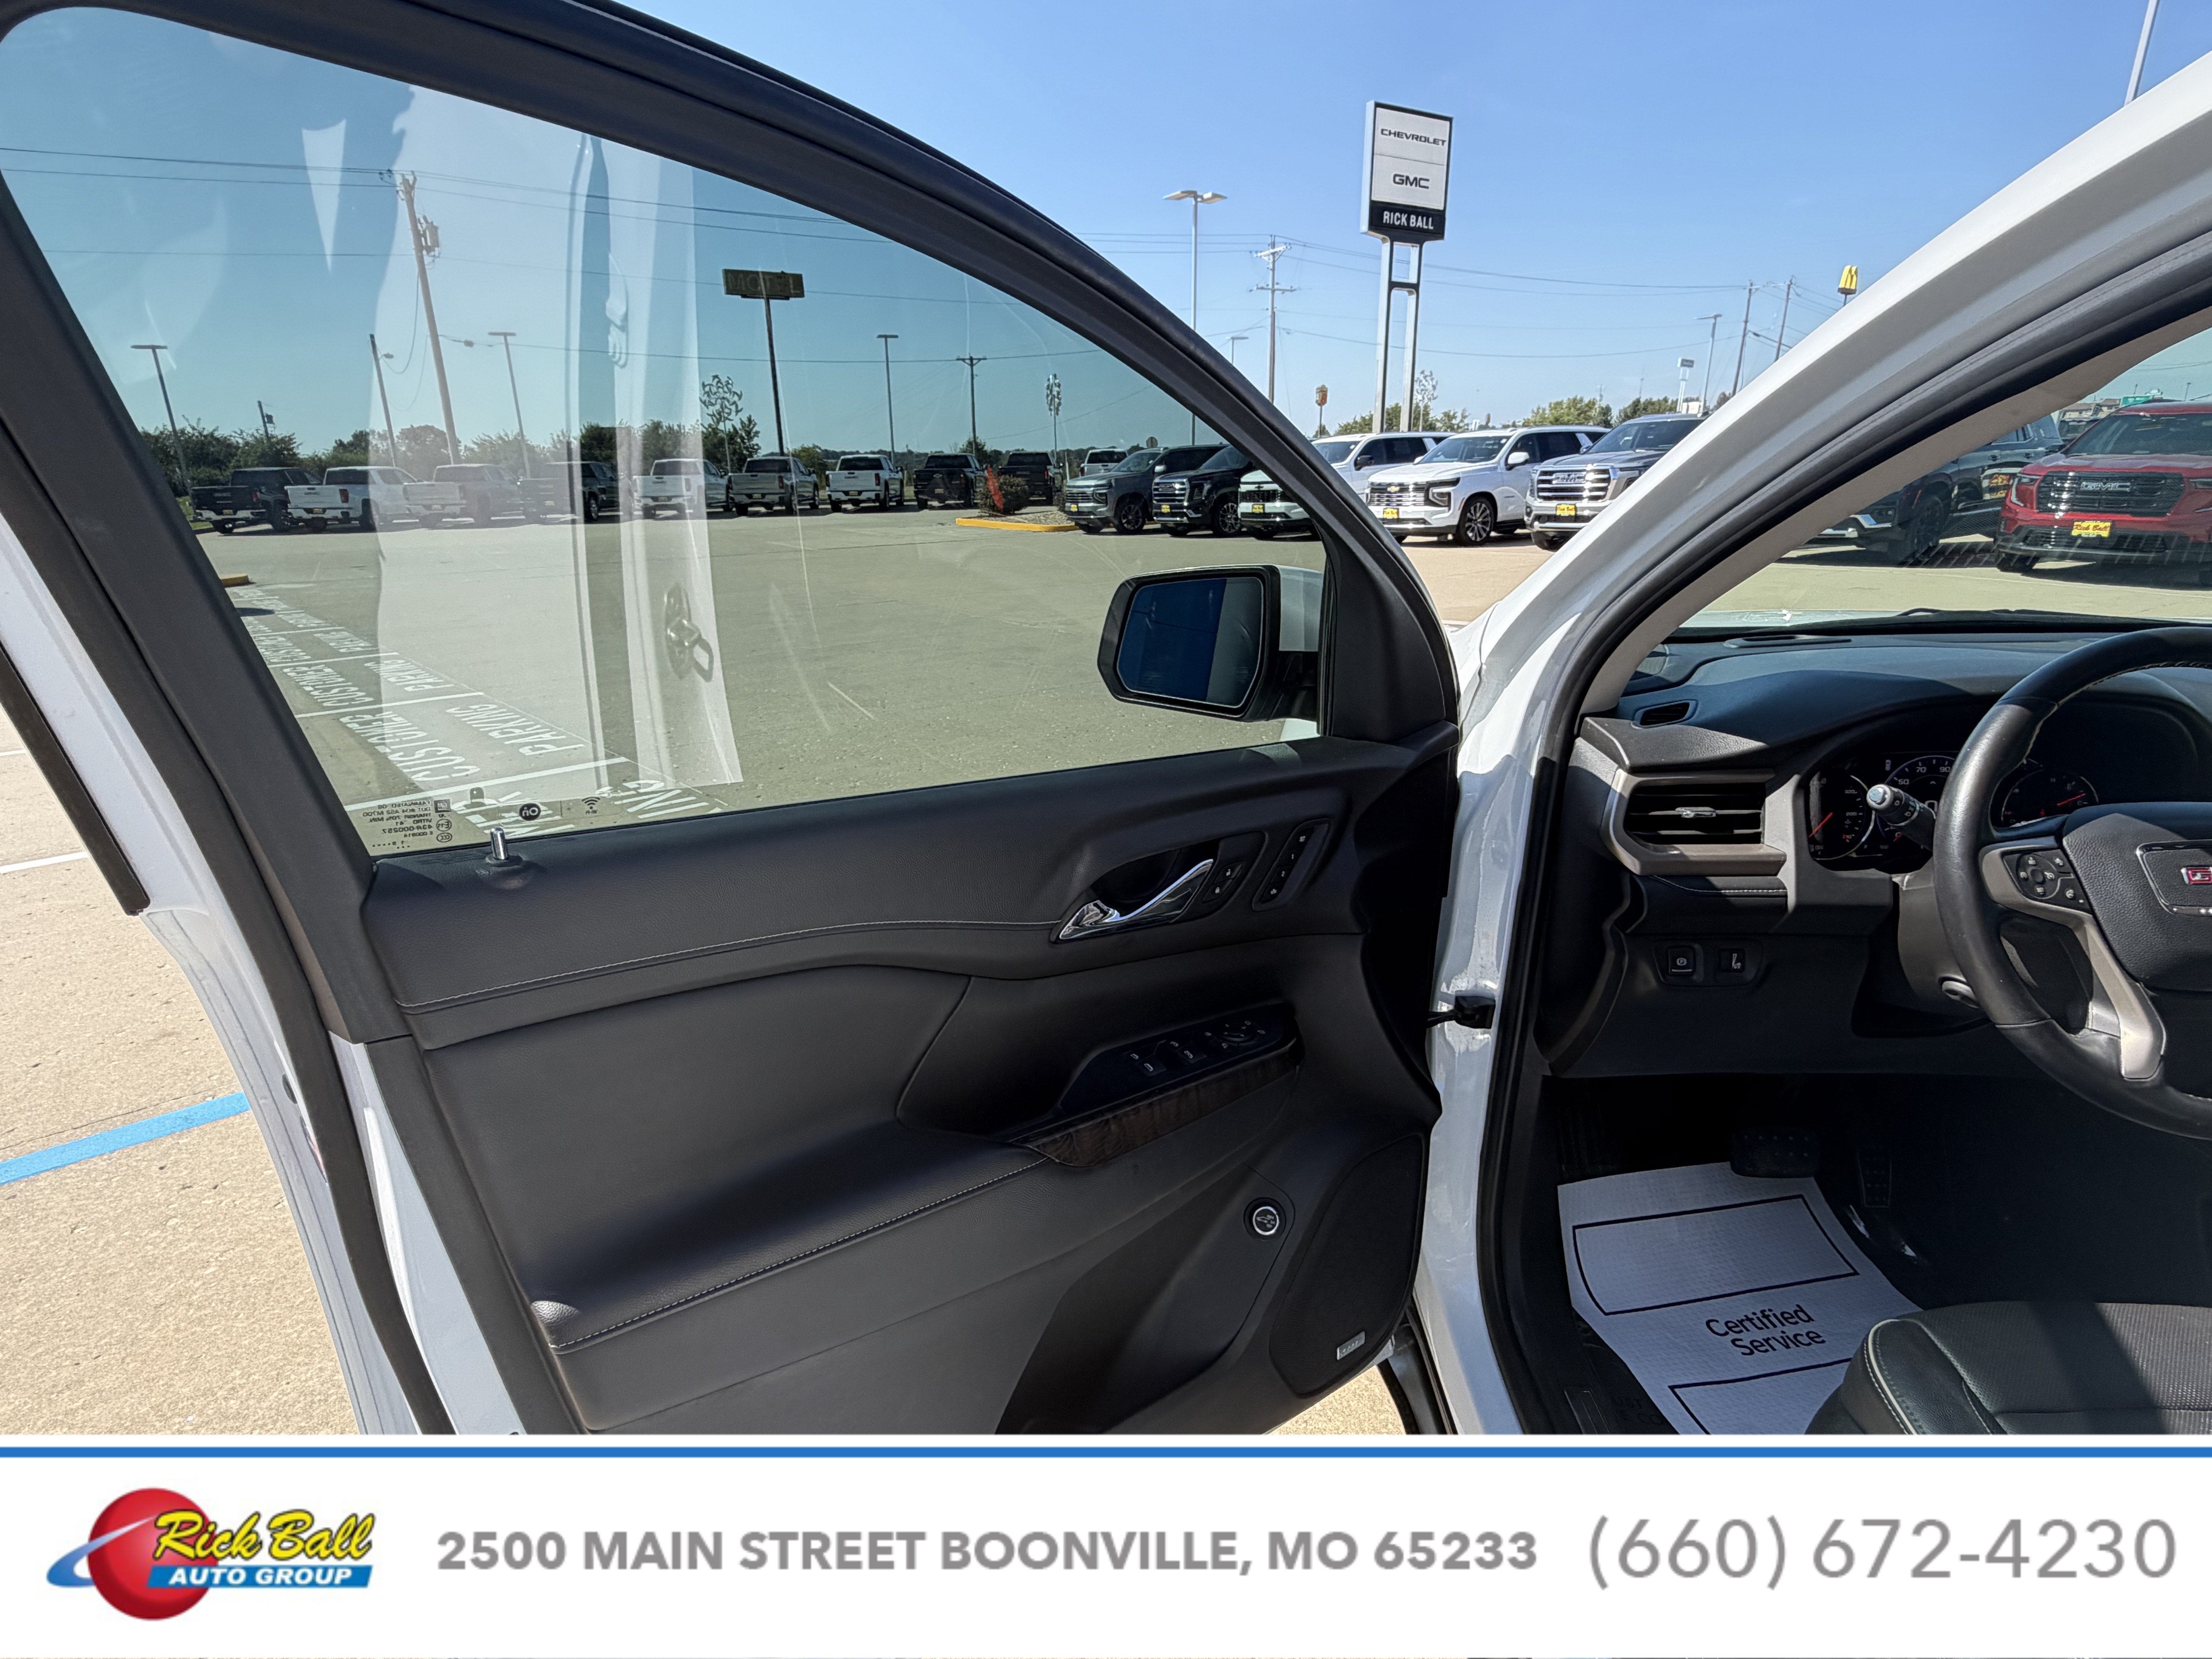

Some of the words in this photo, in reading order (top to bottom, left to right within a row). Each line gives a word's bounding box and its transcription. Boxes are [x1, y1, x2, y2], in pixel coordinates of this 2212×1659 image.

[1381, 129, 1446, 146] CHEVROLET
[1393, 173, 1430, 189] GMC
[1383, 211, 1407, 226] RICK
[1410, 215, 1434, 230] BALL
[728, 272, 801, 294] MOTL
[2080, 482, 2131, 492] GMC
[446, 704, 585, 756] PARKING
[339, 711, 480, 781] CUSTOMER
[1705, 1304, 1814, 1337] Certified
[1730, 1330, 1826, 1356] Service
